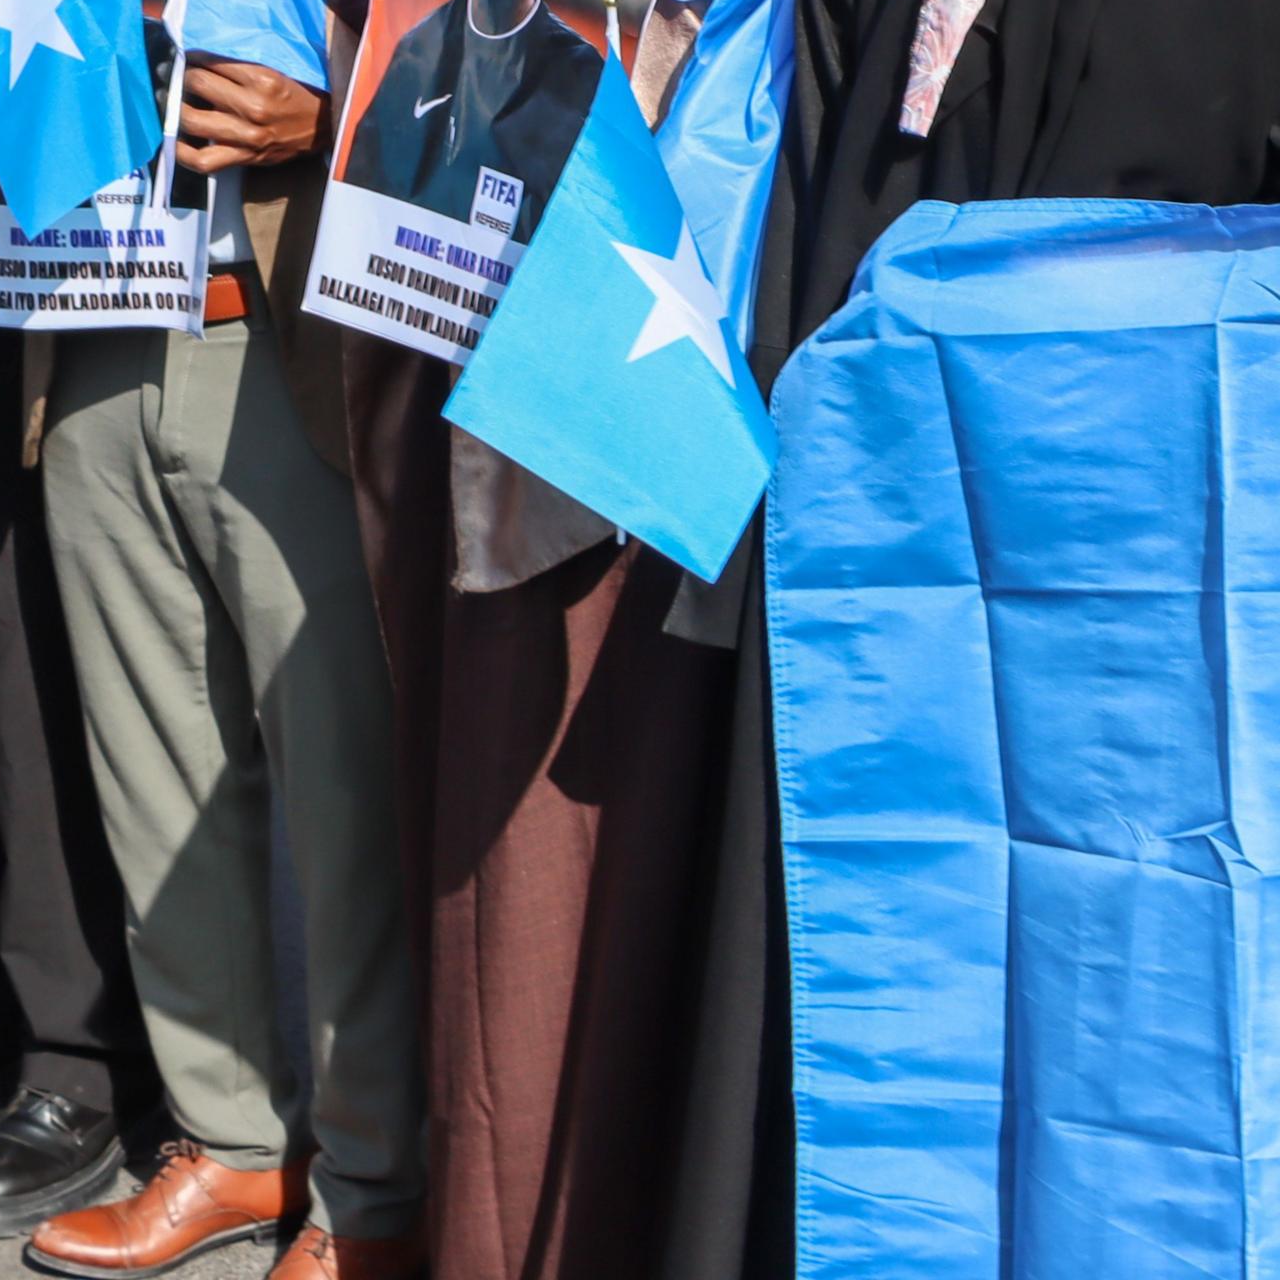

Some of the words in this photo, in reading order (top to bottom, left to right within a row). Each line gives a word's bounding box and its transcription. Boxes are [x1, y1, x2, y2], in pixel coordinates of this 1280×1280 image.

[480, 173, 517, 208] FIFA
[70, 229, 113, 248] OMAR
[117, 229, 166, 248] ARTAN
[29, 260, 101, 280] DHAWOOW
[366, 253, 407, 285] KUSOO
[446, 243, 477, 274] OMAR
[14, 291, 35, 311] IYO
[155, 292, 174, 310] OO
[318, 274, 385, 316] DALKAAGA
[384, 296, 405, 322] IYO
